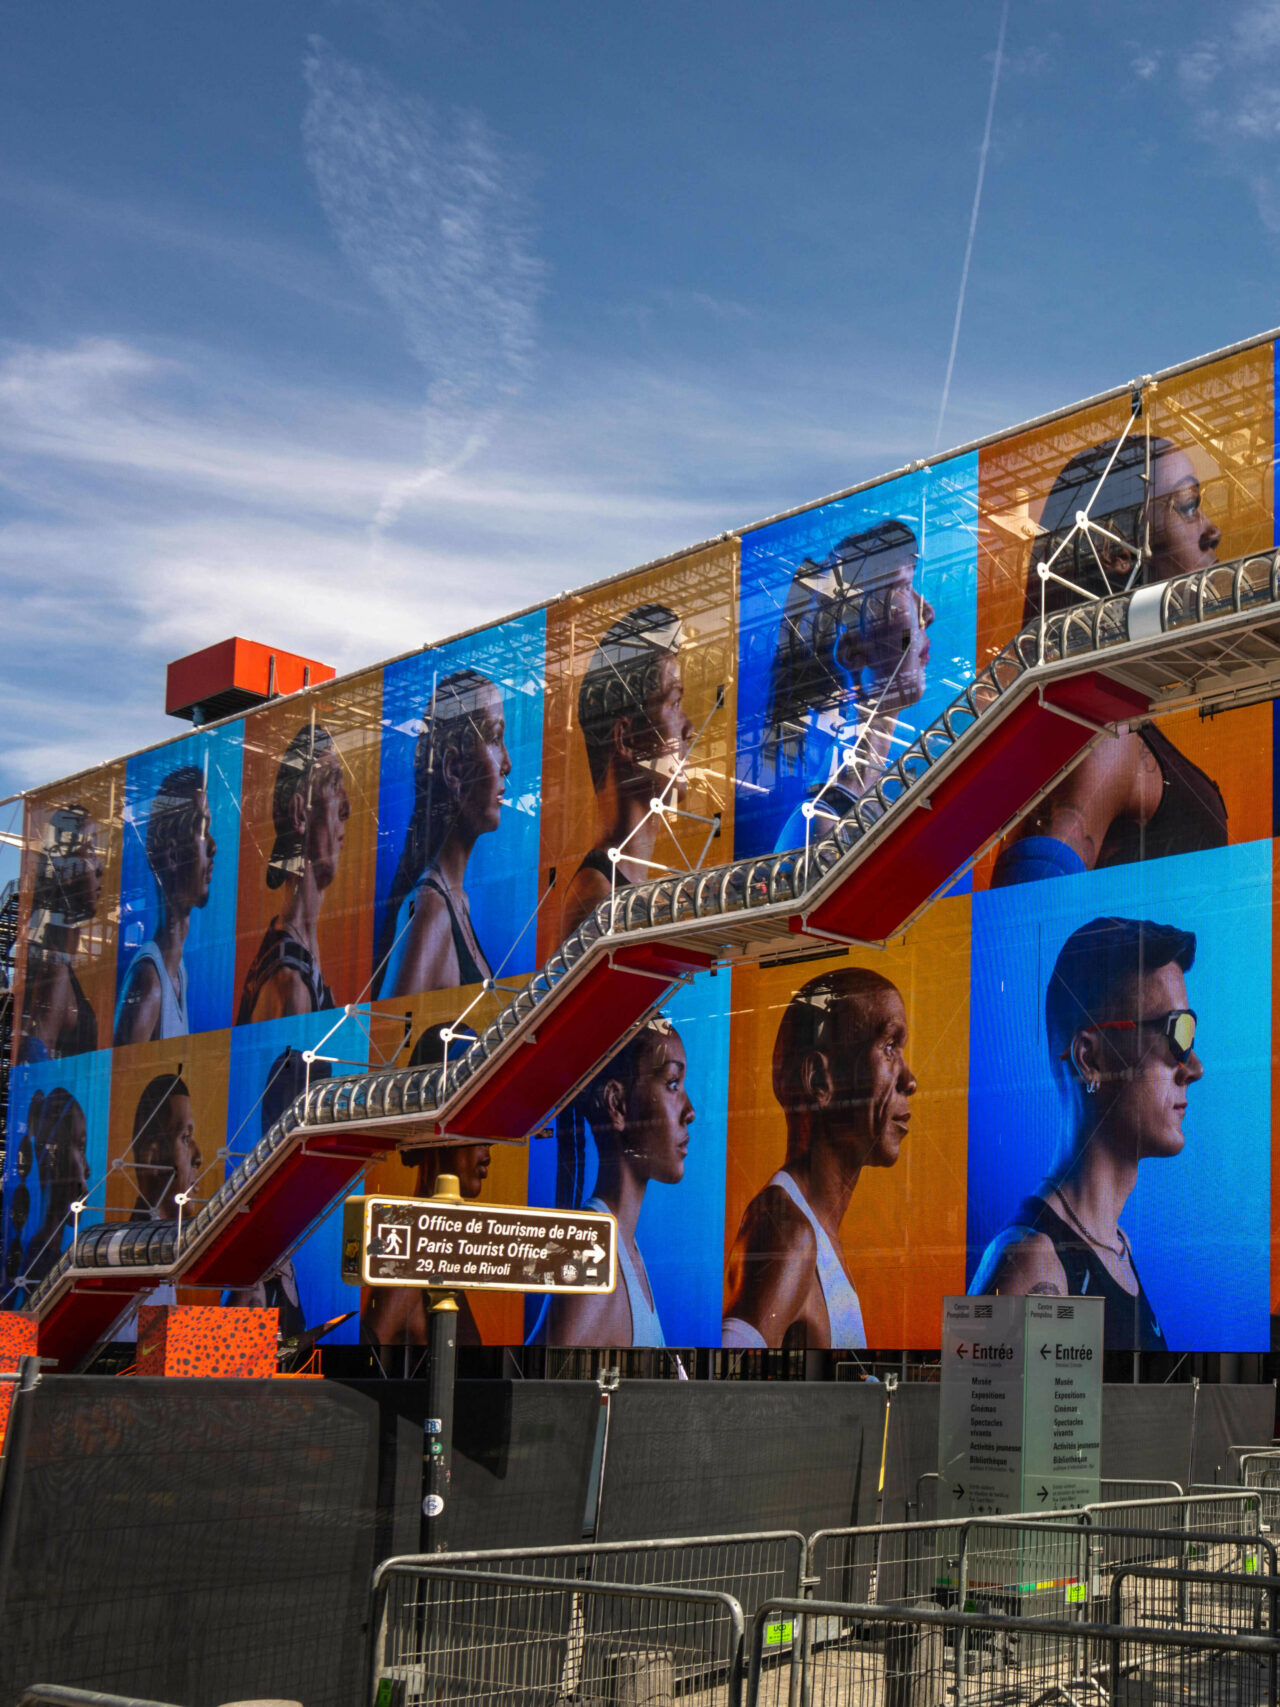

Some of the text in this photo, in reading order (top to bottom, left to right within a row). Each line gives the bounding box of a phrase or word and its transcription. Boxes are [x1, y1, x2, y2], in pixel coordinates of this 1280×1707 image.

[418, 1215, 598, 1241] Office de Tourisme de Paris
[417, 1237, 548, 1260] Paris Tourist Office
[416, 1259, 511, 1276] 29, Rue de Rivoli
[972, 1342, 1014, 1360] Entrée
[1055, 1343, 1093, 1361] Entrée
[972, 1377, 992, 1386] Musée
[1055, 1377, 1074, 1386] Musée
[971, 1391, 1006, 1401] Expositions
[1055, 1391, 1086, 1400] Expositions
[971, 1404, 997, 1413] Cinémas
[971, 1418, 1003, 1428] Spectacles
[1054, 1418, 1084, 1428] Spectacles
[970, 1429, 992, 1438] vivants
[1054, 1429, 1074, 1438] vivants
[970, 1442, 995, 1452] Activités
[1053, 1442, 1077, 1451] Activités
[969, 1455, 1008, 1466] Bibliothèque
[1053, 1455, 1088, 1465] Bibliothèque
